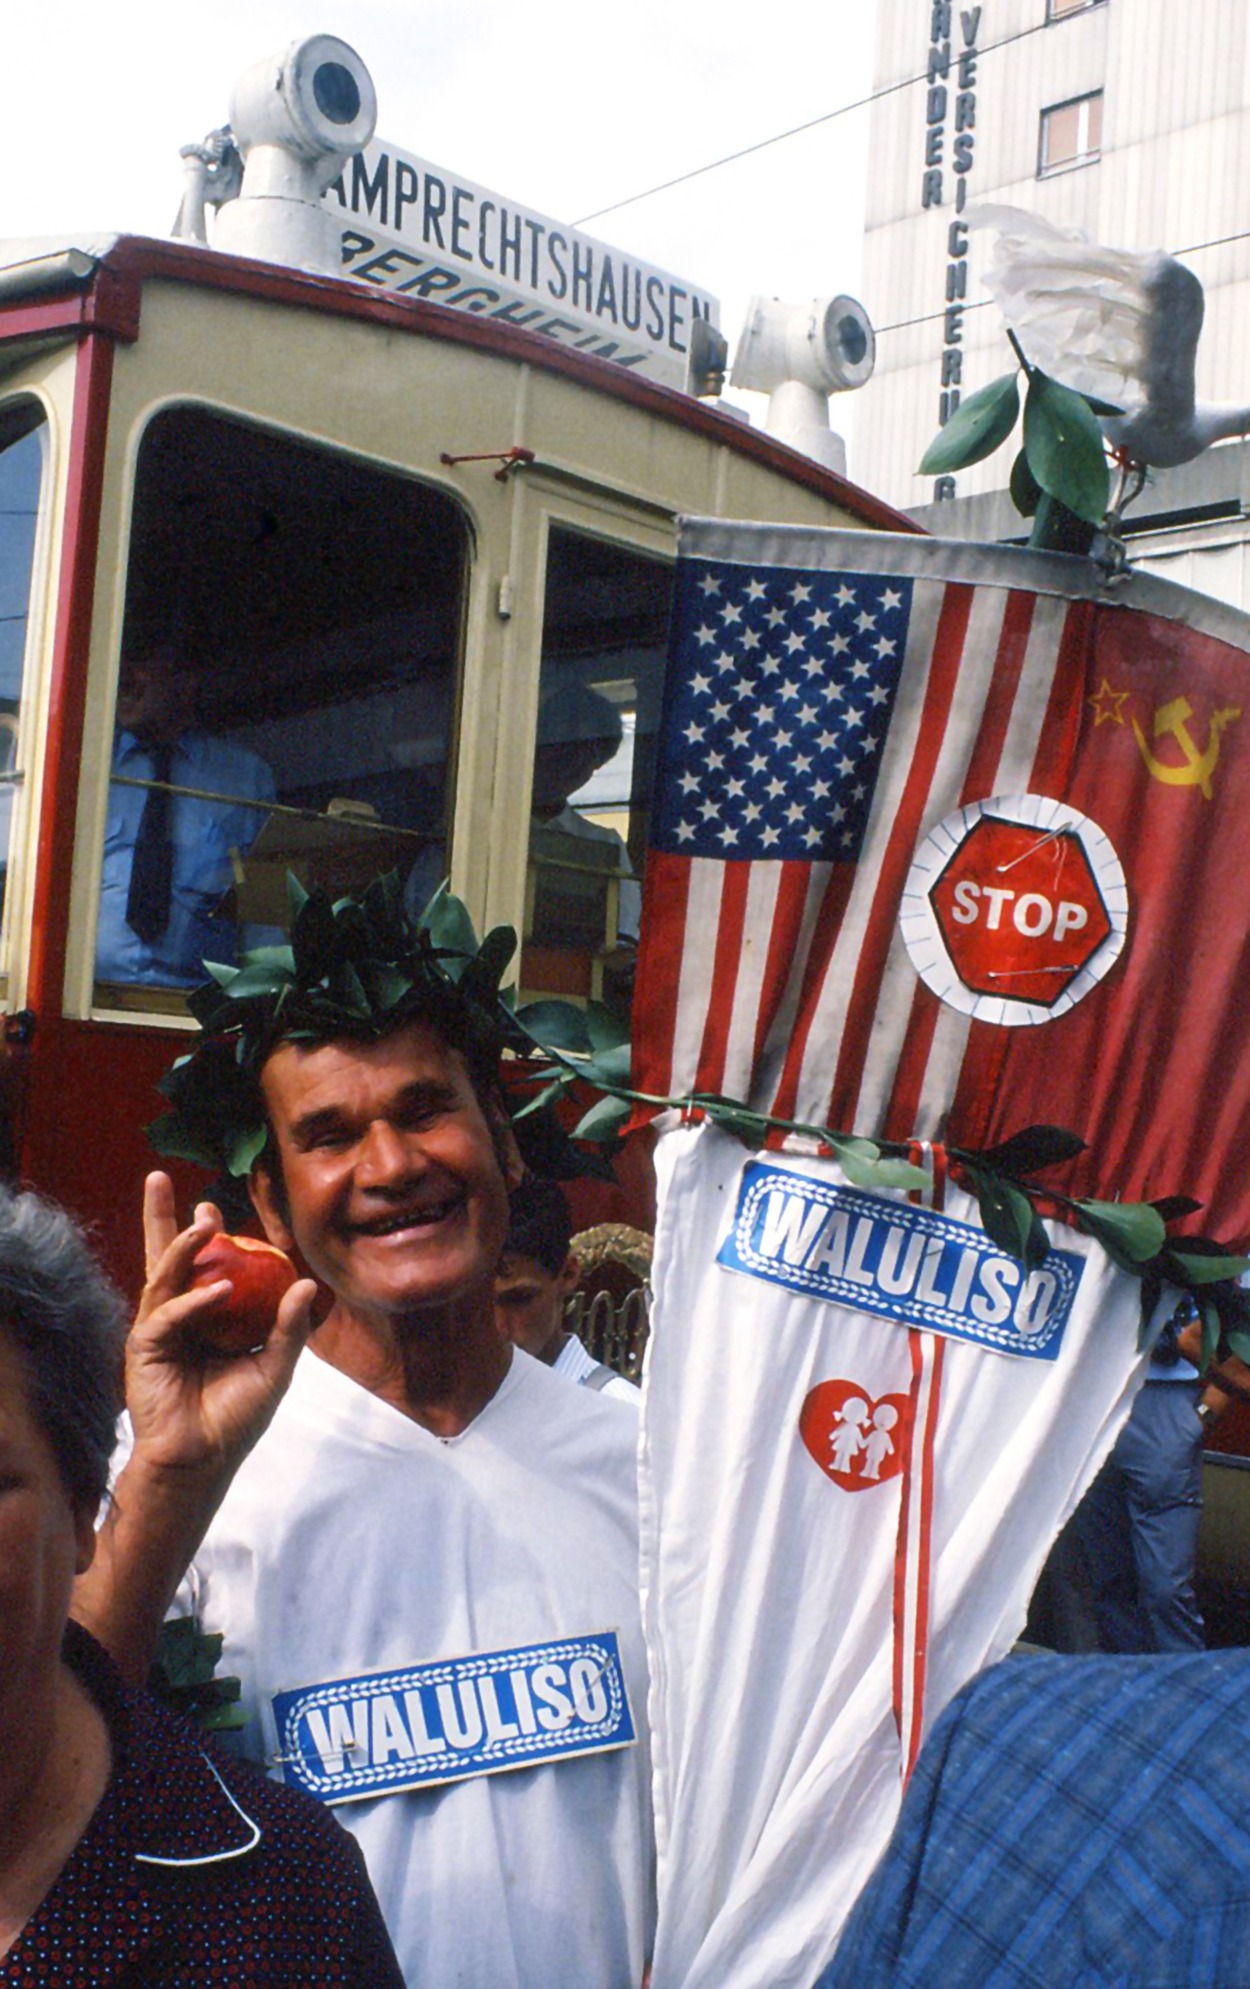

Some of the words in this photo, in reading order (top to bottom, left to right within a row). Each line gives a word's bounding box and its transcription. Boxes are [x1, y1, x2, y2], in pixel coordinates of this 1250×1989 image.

[933, 6, 982, 501] VERSICHERUG
[952, 881, 1087, 942] STOP
[759, 1191, 1057, 1335] WALULISO
[306, 1658, 608, 1775] WALULISO
